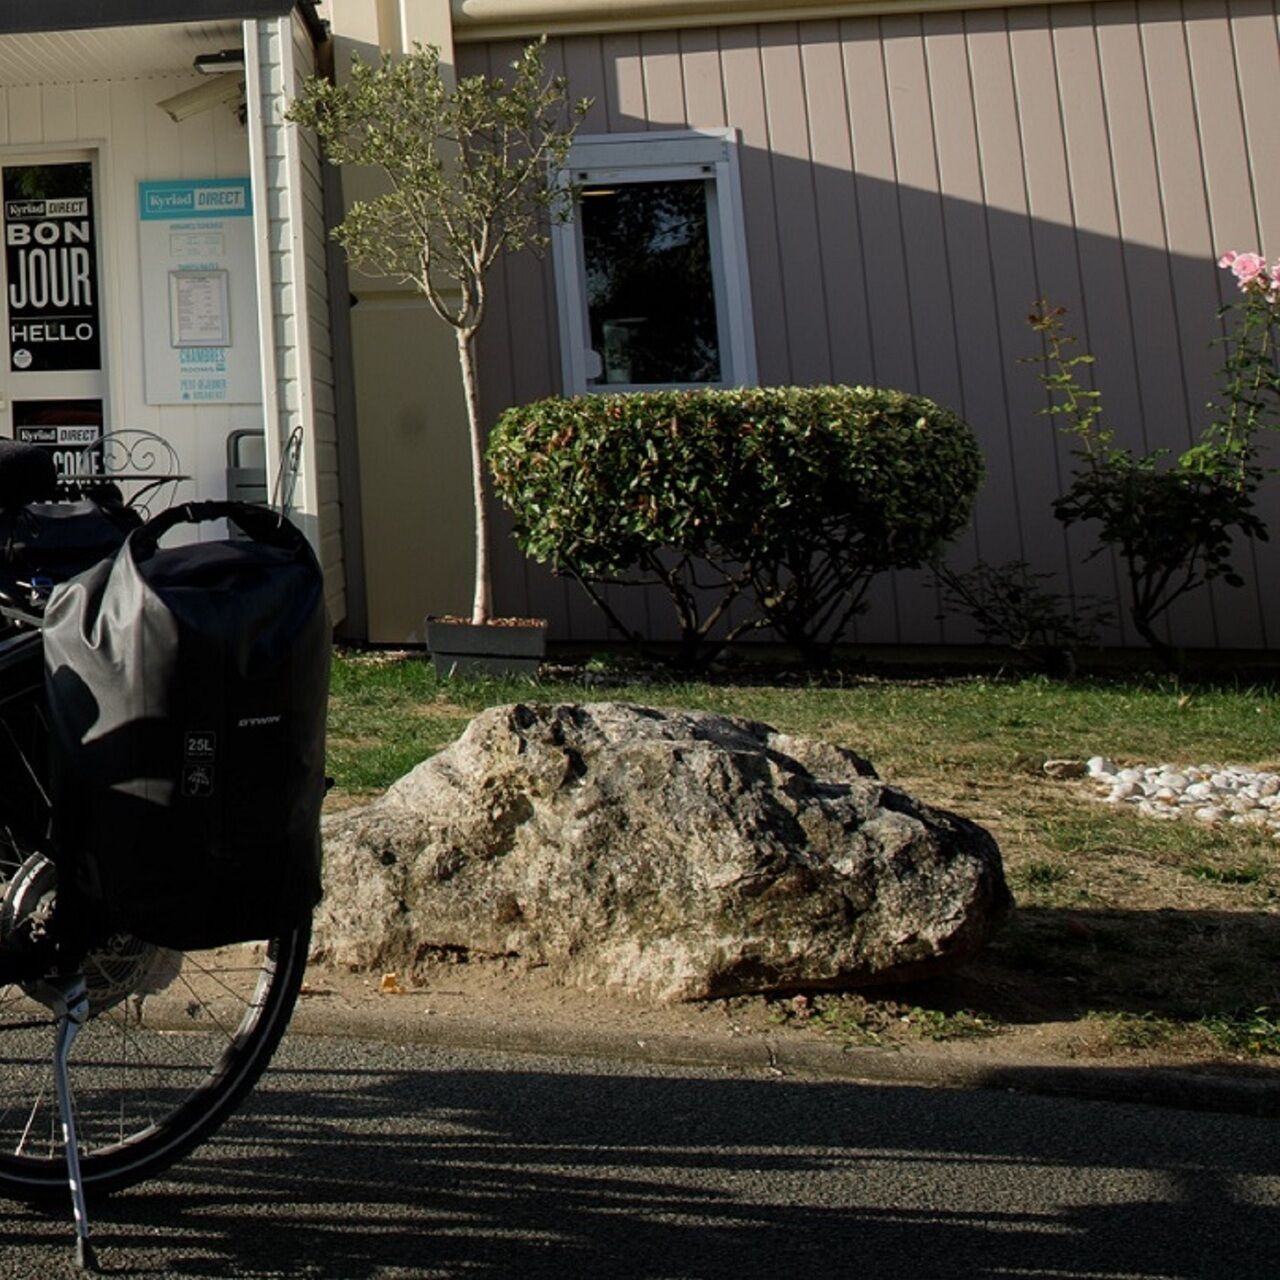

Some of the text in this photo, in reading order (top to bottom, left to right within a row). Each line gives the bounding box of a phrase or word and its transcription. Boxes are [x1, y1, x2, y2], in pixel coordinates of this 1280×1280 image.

[10, 201, 84, 217] Kyriad DIRECT
[150, 191, 242, 209] Kyriad DIRECT
[7, 221, 90, 245] BON
[10, 247, 92, 309] JOUR
[11, 323, 93, 342] HELLO
[60, 429, 96, 441] DIRECT
[188, 738, 213, 752] 25L
